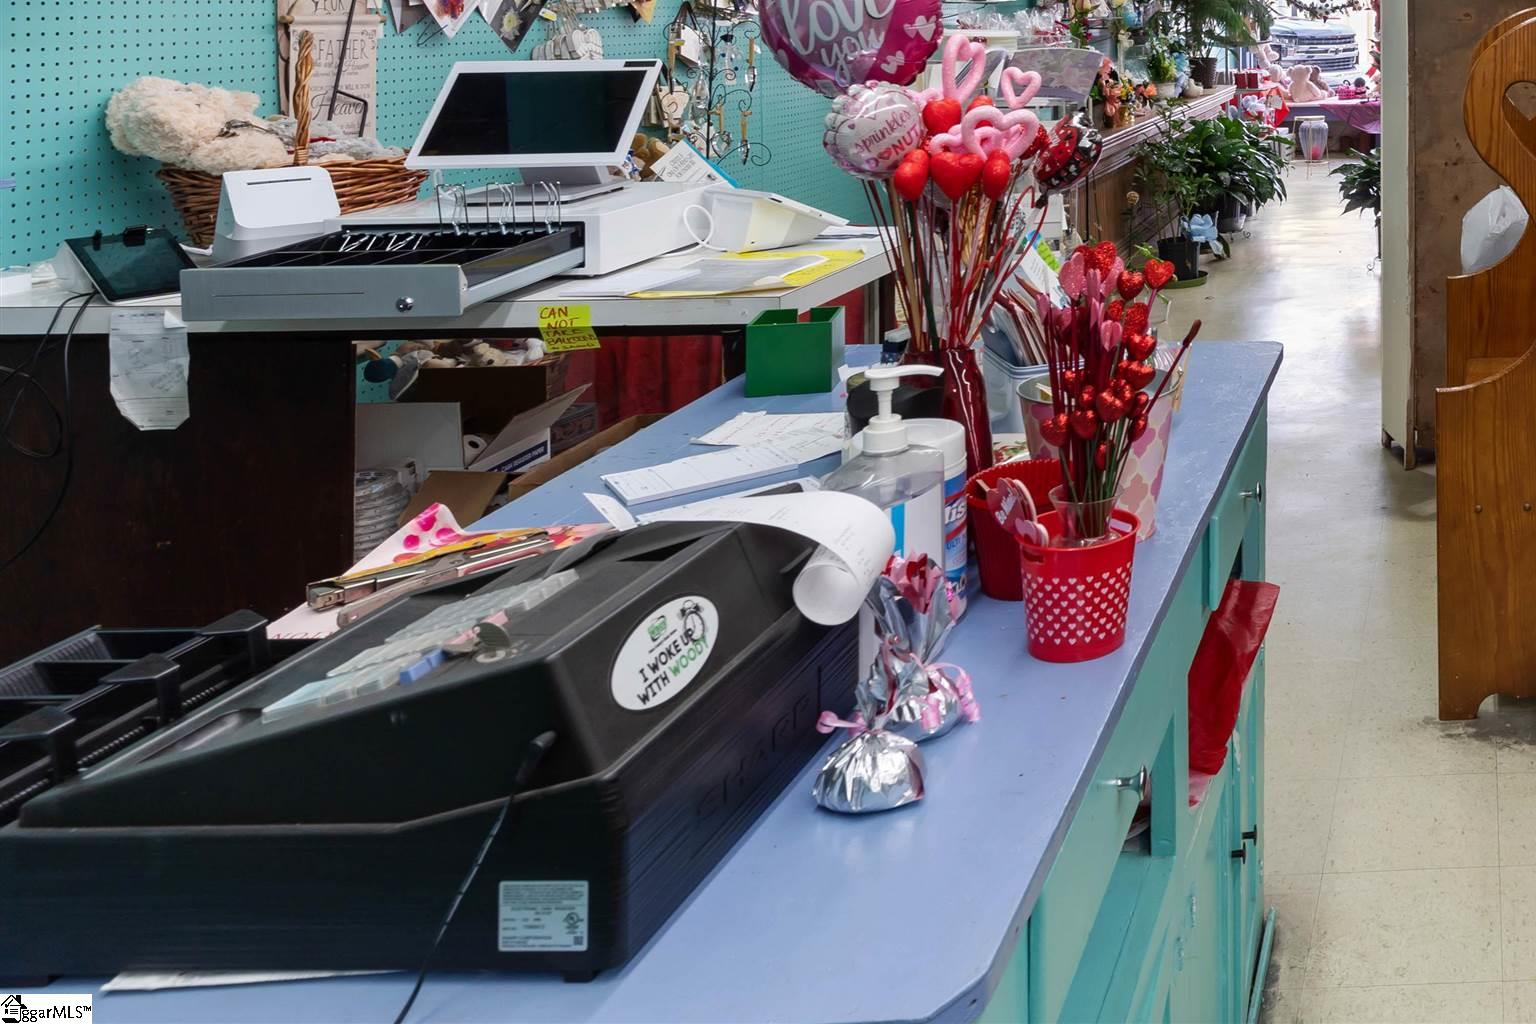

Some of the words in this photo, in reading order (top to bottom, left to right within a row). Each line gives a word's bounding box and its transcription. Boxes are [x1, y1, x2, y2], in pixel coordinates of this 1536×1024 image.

[820, 28, 886, 85] you
[540, 306, 569, 320] CAN
[546, 316, 580, 330] NOT
[636, 670, 671, 706] WITH
[668, 635, 709, 677] WOODY
[639, 667, 649, 683] I
[646, 639, 682, 675] WOKE
[680, 627, 695, 647] UP
